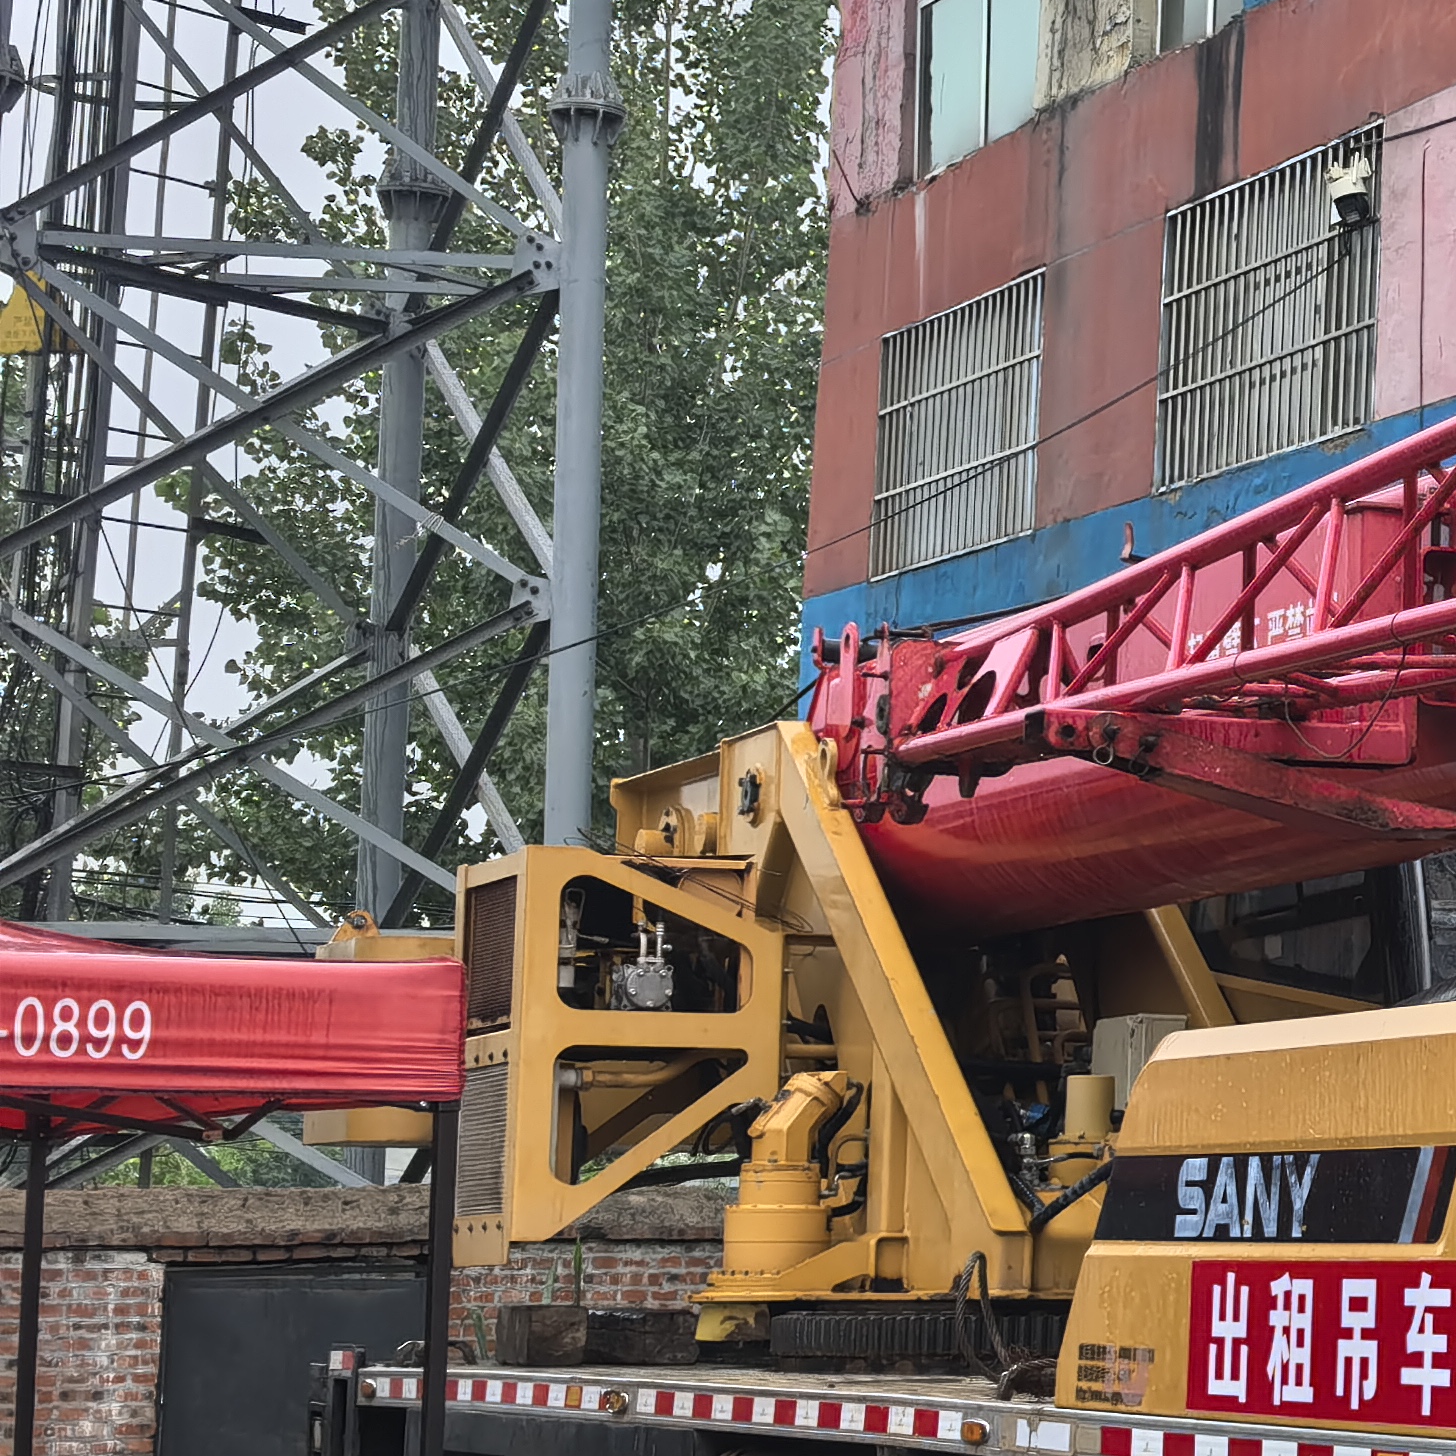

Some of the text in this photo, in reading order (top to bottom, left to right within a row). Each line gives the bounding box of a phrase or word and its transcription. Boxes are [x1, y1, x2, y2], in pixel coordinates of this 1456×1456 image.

[1174, 1153, 1321, 1238] SANY
[1207, 1271, 1453, 1417] 出租吊车
